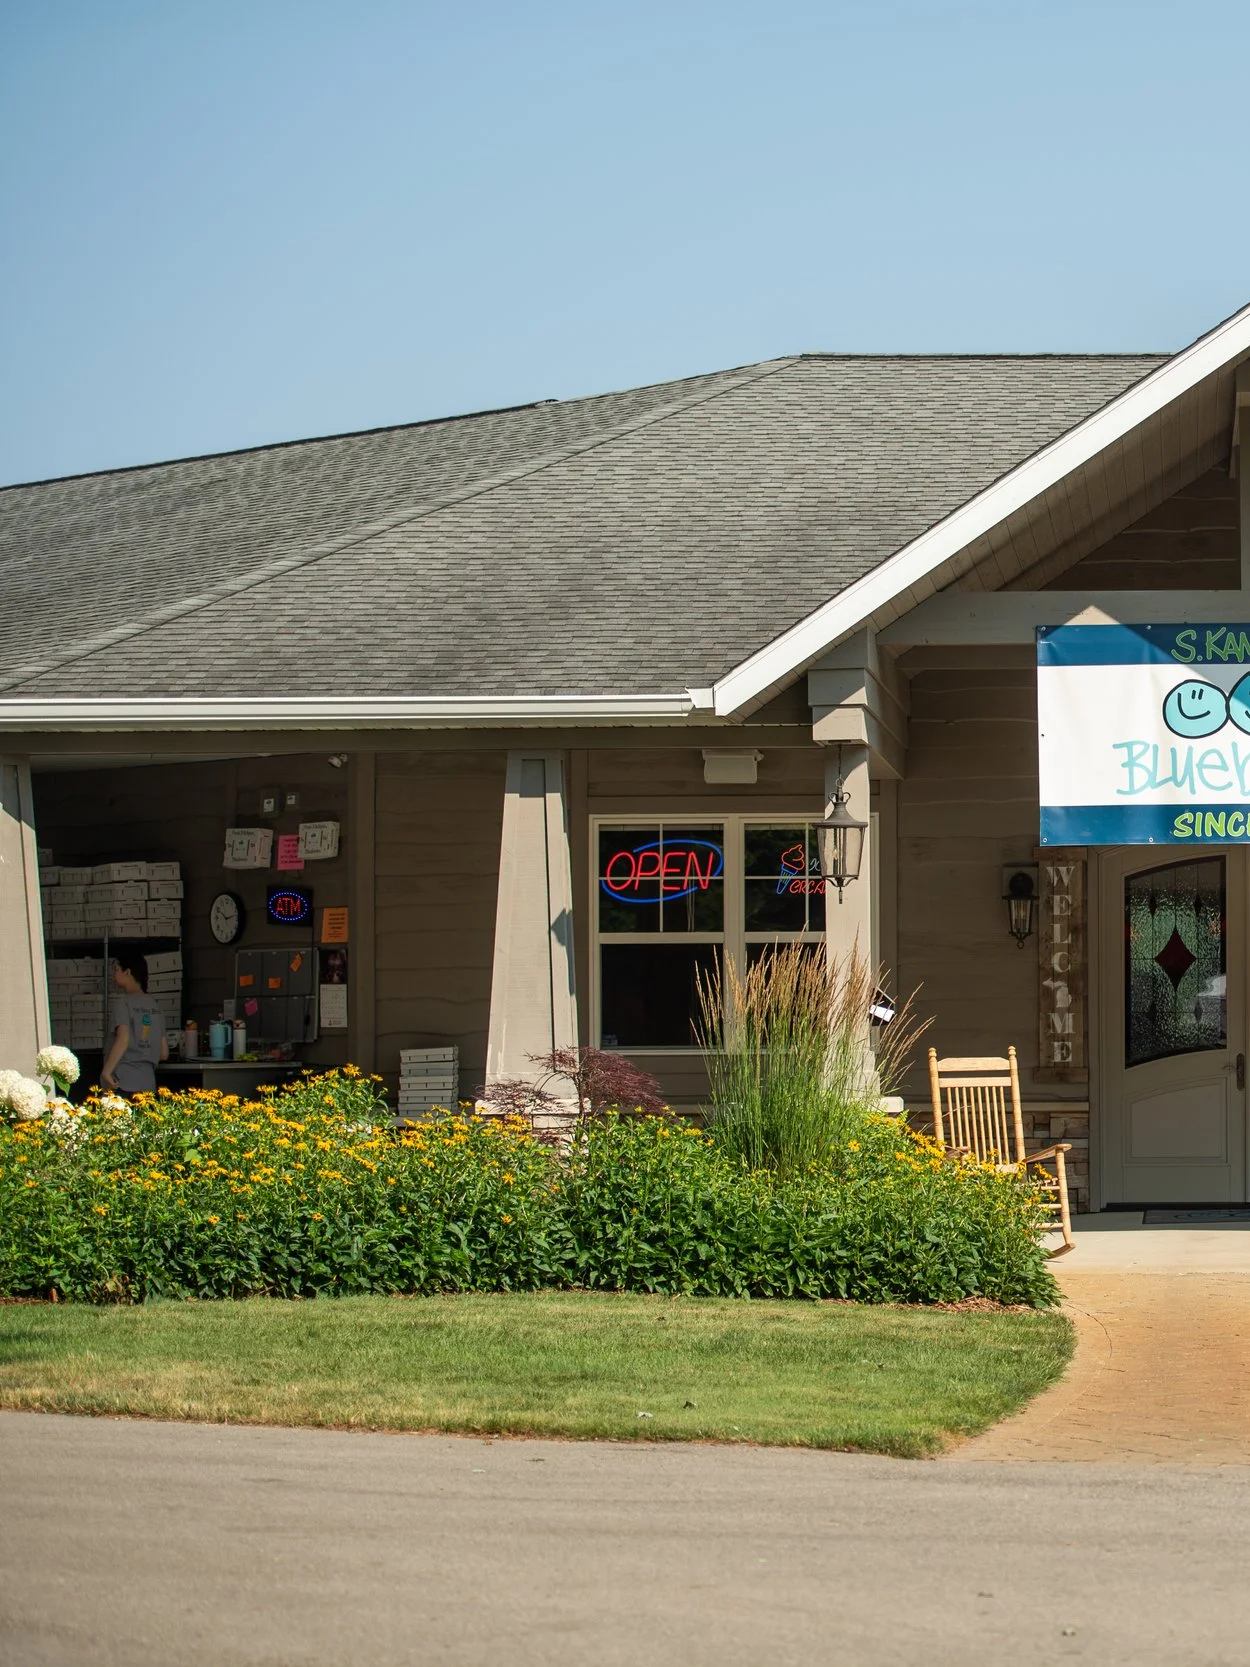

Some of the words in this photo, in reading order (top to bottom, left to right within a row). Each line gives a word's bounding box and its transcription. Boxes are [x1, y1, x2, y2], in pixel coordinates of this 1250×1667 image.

[606, 851, 713, 890] OPEN
[790, 879, 826, 894] CREA
[276, 897, 301, 916] ATM
[1043, 866, 1075, 1063] WELCME
